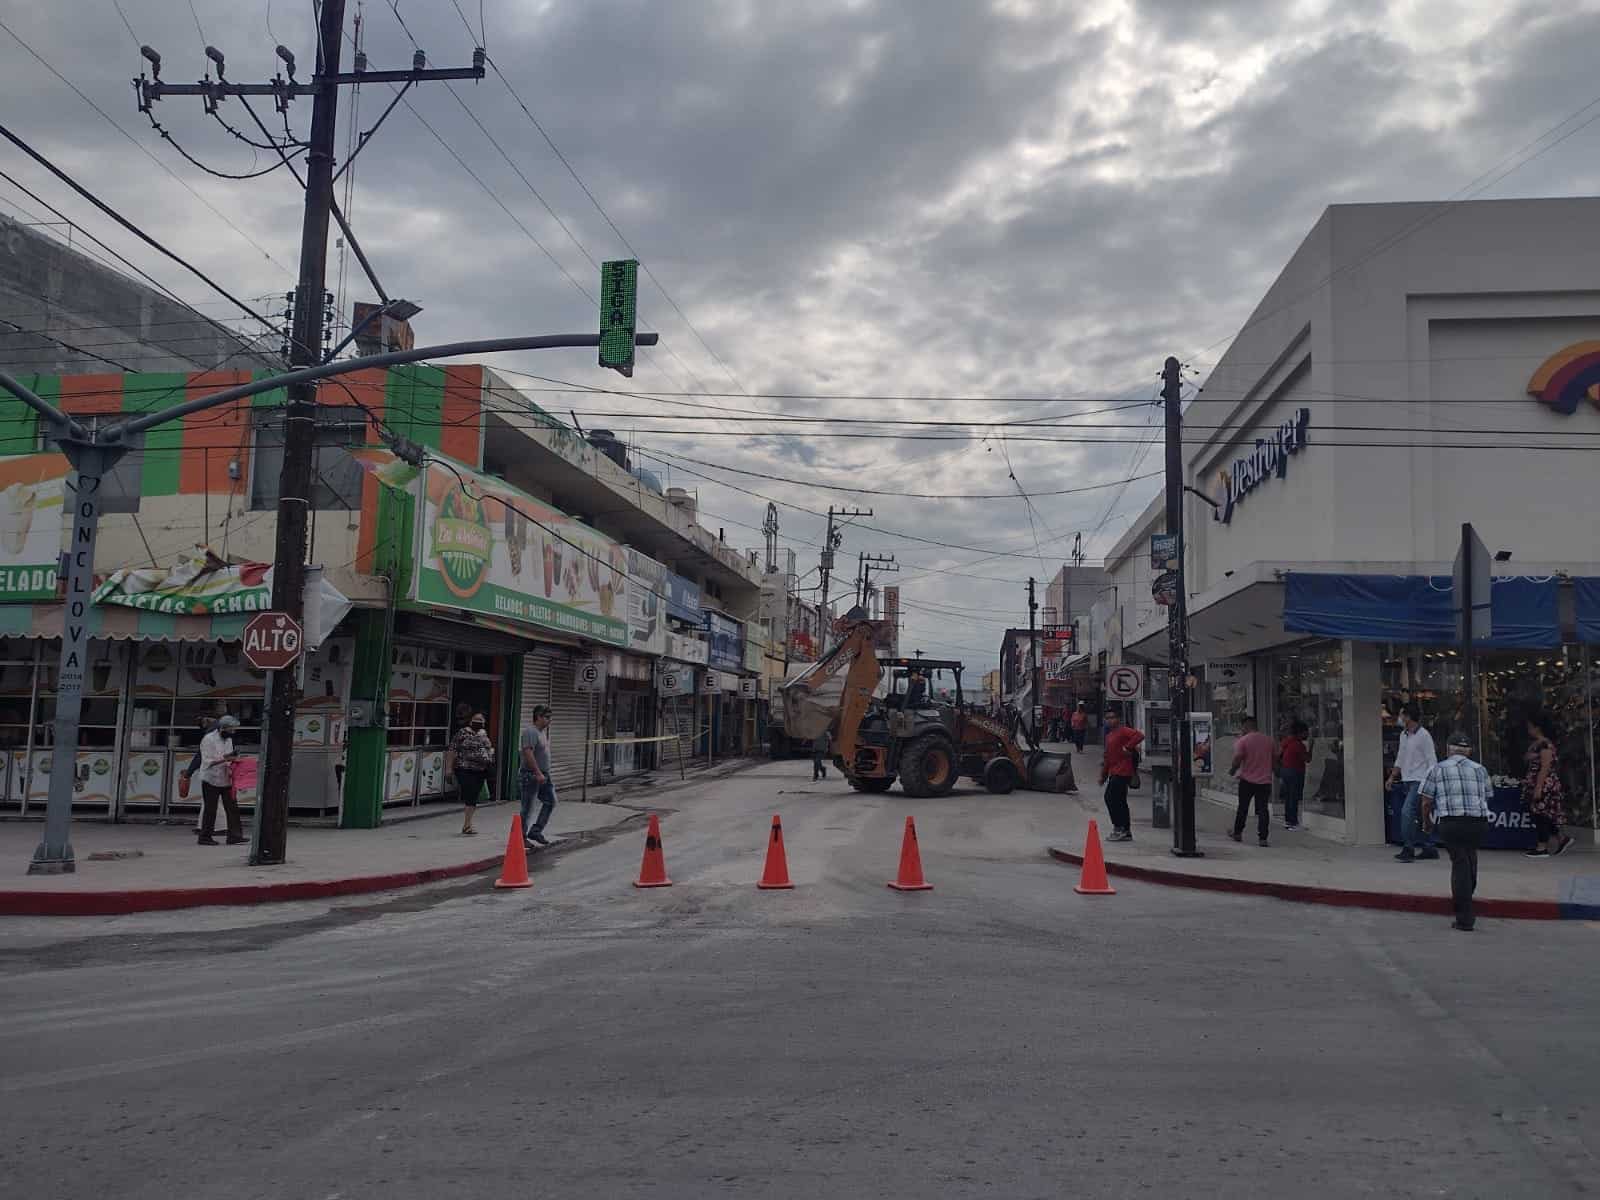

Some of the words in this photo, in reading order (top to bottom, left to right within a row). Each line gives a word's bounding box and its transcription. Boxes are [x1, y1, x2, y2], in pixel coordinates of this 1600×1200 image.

[1230, 408, 1309, 503] Destroyer
[246, 628, 299, 653] ALTO
[825, 648, 857, 675] CASE
